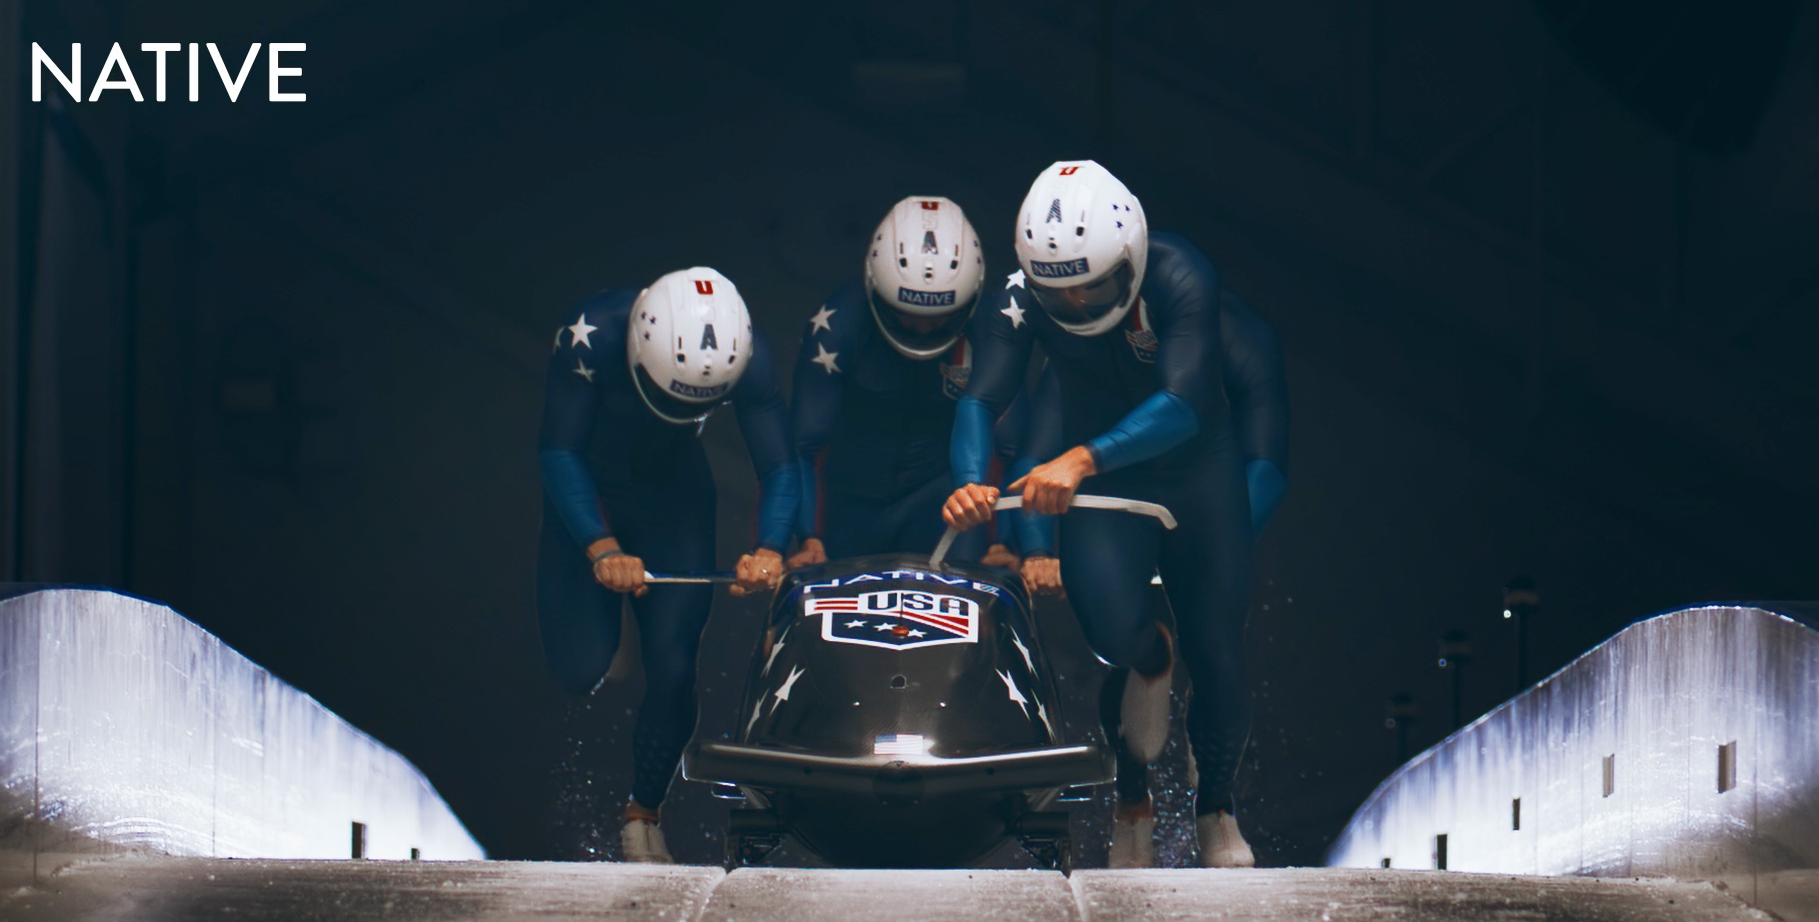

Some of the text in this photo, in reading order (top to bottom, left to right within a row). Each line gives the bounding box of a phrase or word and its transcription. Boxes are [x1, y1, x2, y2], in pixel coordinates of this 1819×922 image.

[1033, 260, 1085, 277] NATIVE
[901, 290, 954, 304] NATIVE
[868, 593, 969, 617] USA
